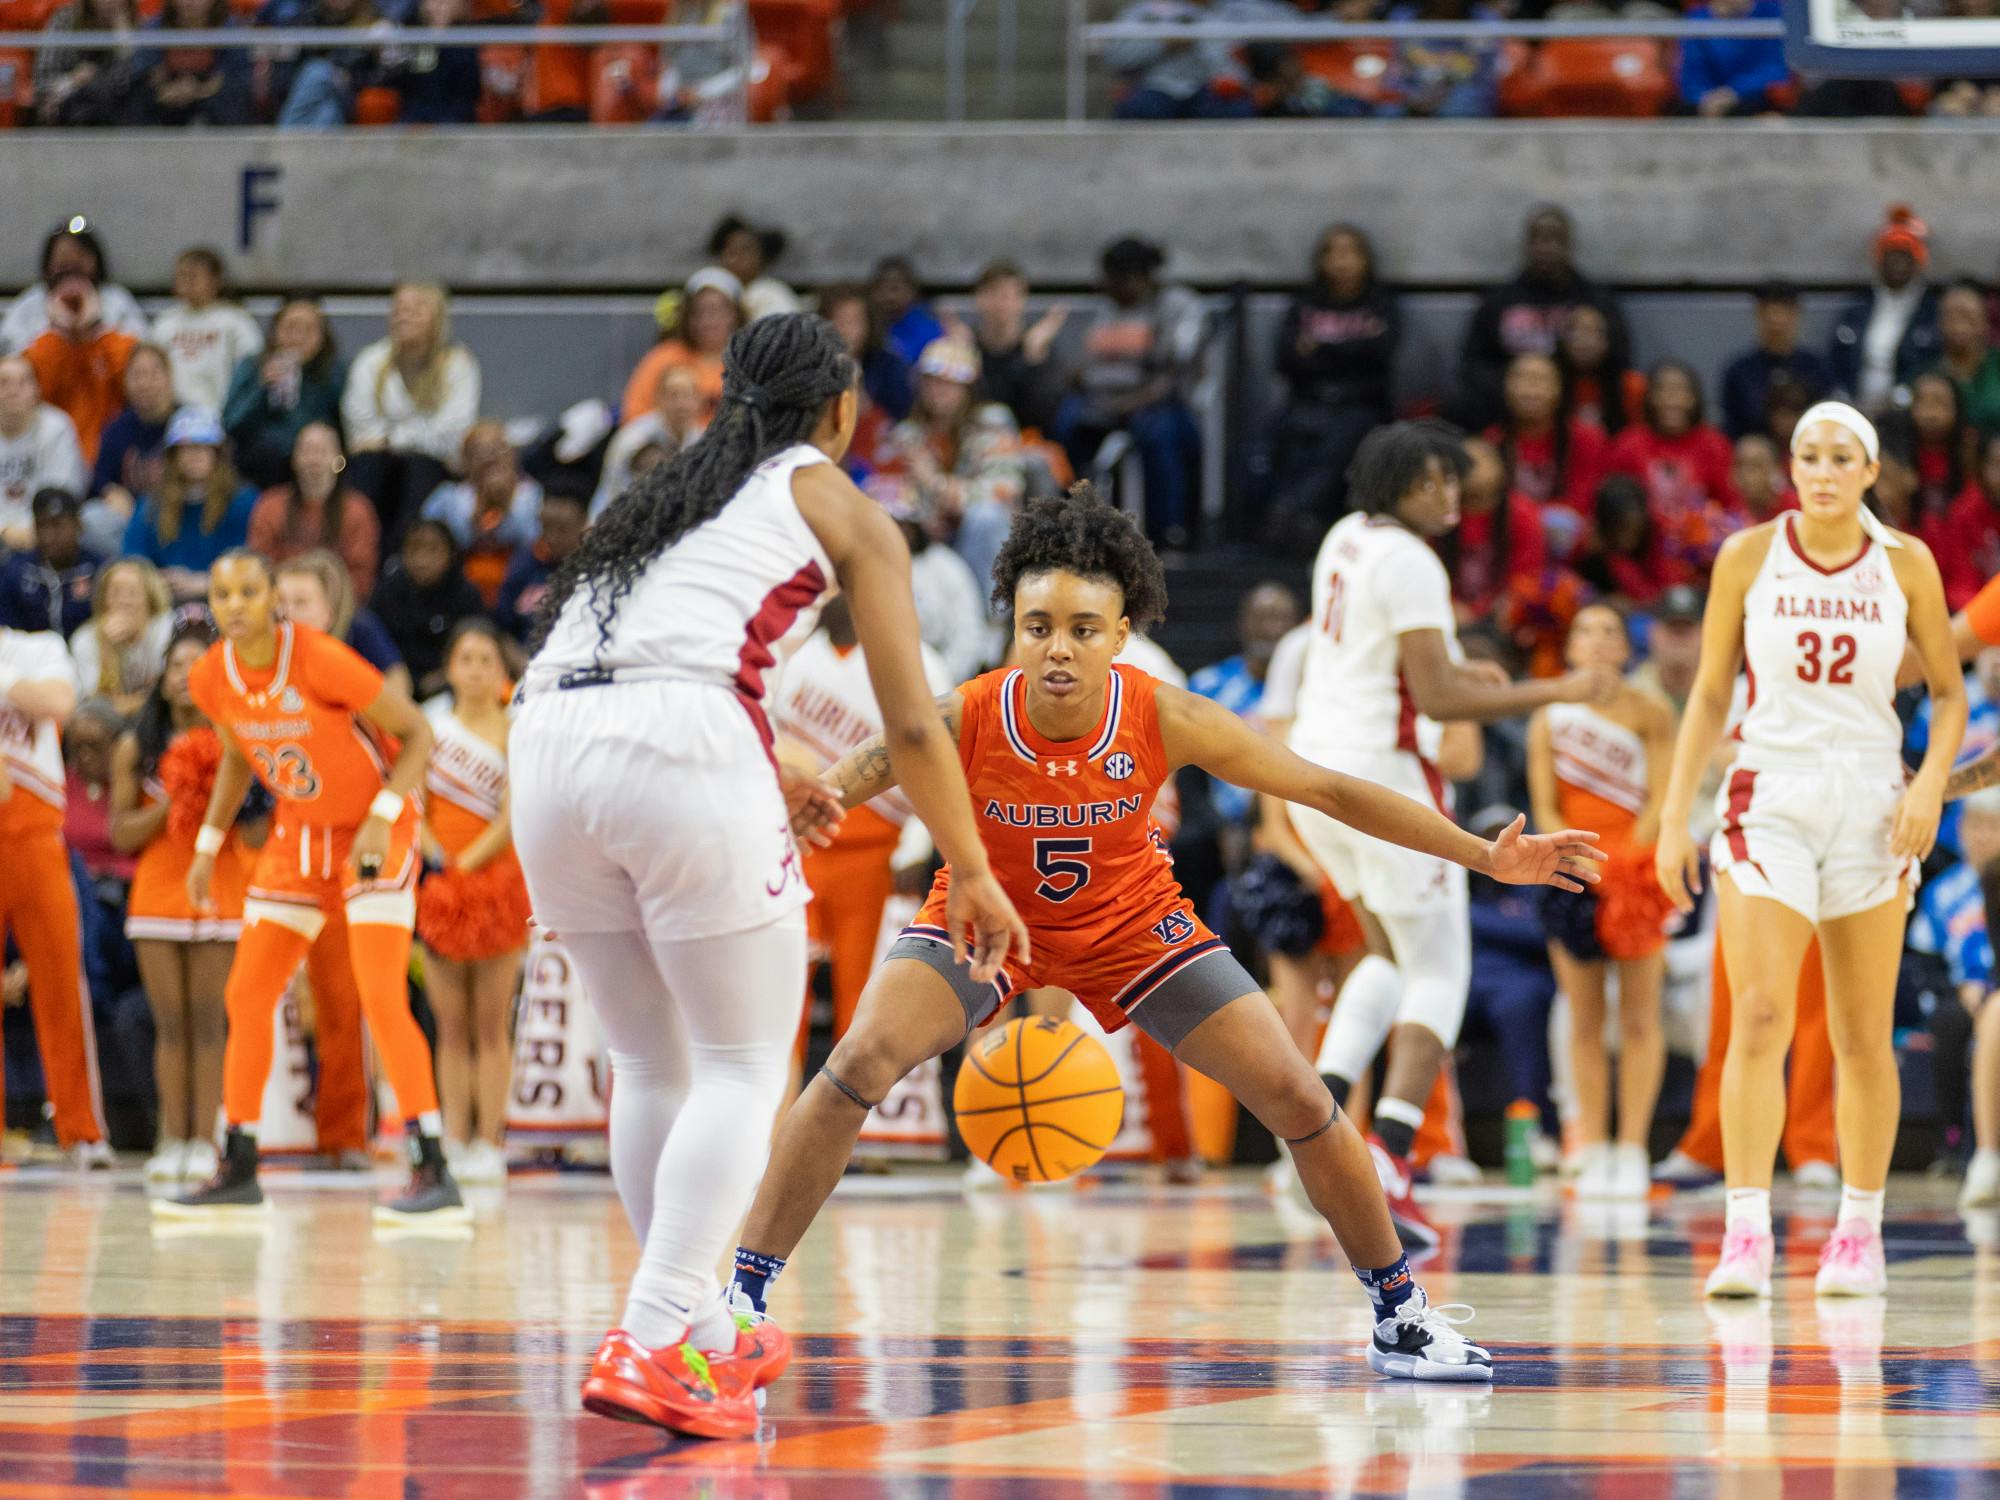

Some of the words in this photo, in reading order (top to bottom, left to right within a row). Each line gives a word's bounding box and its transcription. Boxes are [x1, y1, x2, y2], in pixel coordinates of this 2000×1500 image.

[238, 165, 283, 249] F
[1774, 595, 1882, 623] ALABAMA
[1796, 630, 1857, 684] 32
[1105, 753, 1135, 780] SEC
[984, 793, 1142, 828] AUBURN
[1033, 837, 1093, 904] 5
